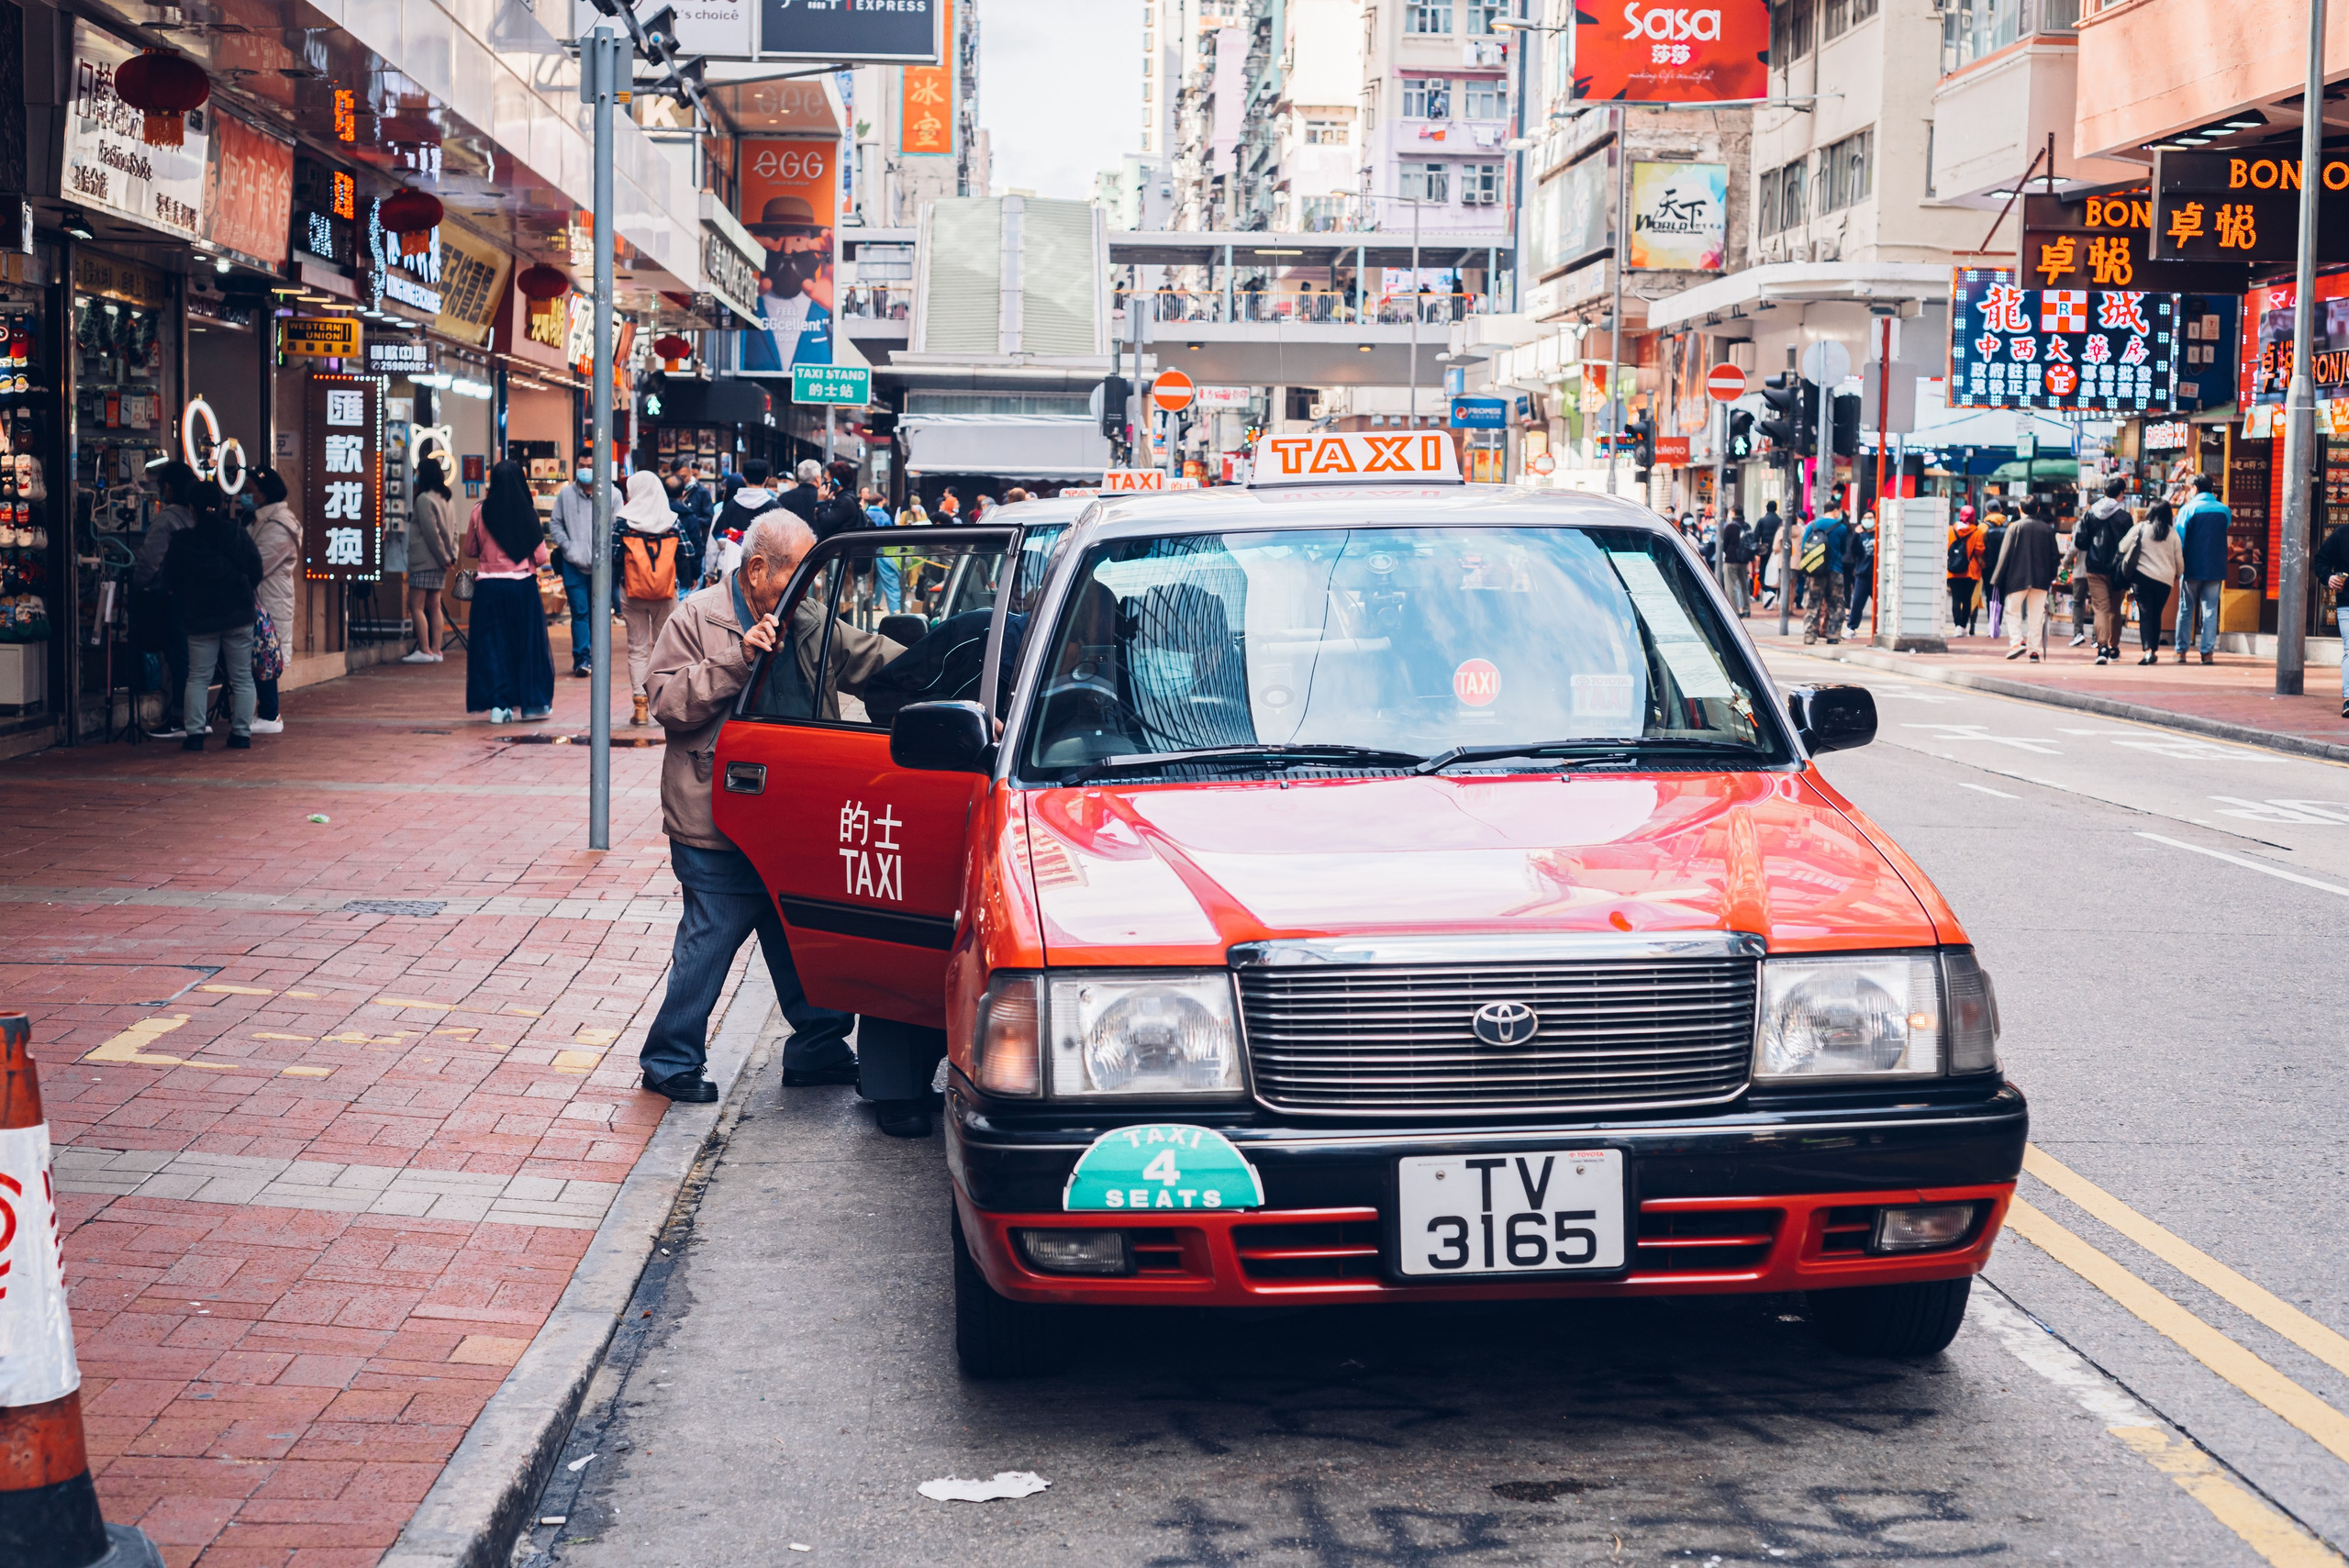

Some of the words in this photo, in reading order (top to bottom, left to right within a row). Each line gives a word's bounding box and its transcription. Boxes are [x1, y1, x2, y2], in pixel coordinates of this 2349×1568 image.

[856, 0, 927, 12] EXPRESS
[1652, 43, 1690, 65] 莎莎
[909, 66, 944, 147] 冰室
[2230, 158, 2349, 191] BONO
[1659, 188, 1708, 230] 天下
[776, 307, 797, 316] FEEL
[289, 322, 341, 331] WESTERN
[306, 331, 341, 340] UNION
[762, 317, 829, 331] GGcellent”
[1976, 332, 2151, 366] 中西大藥房
[796, 368, 824, 379] TAXI
[826, 369, 866, 381] STAND
[2311, 351, 2349, 387] ONJ
[808, 383, 854, 398] 的士站
[1271, 436, 1442, 474] TAXI
[1108, 473, 1162, 491] TAXI
[1457, 672, 1497, 695] TAXI
[1591, 677, 1629, 685] TOYOTA
[1575, 684, 1630, 711] TAXI
[840, 799, 902, 851] 的士
[839, 848, 903, 901] TAXI
[1122, 1127, 1203, 1149] TAXI
[1142, 1149, 1181, 1186] 4
[1465, 1156, 1555, 1212] TV
[1105, 1189, 1222, 1208] SEATS
[1427, 1209, 1597, 1270] 3165
